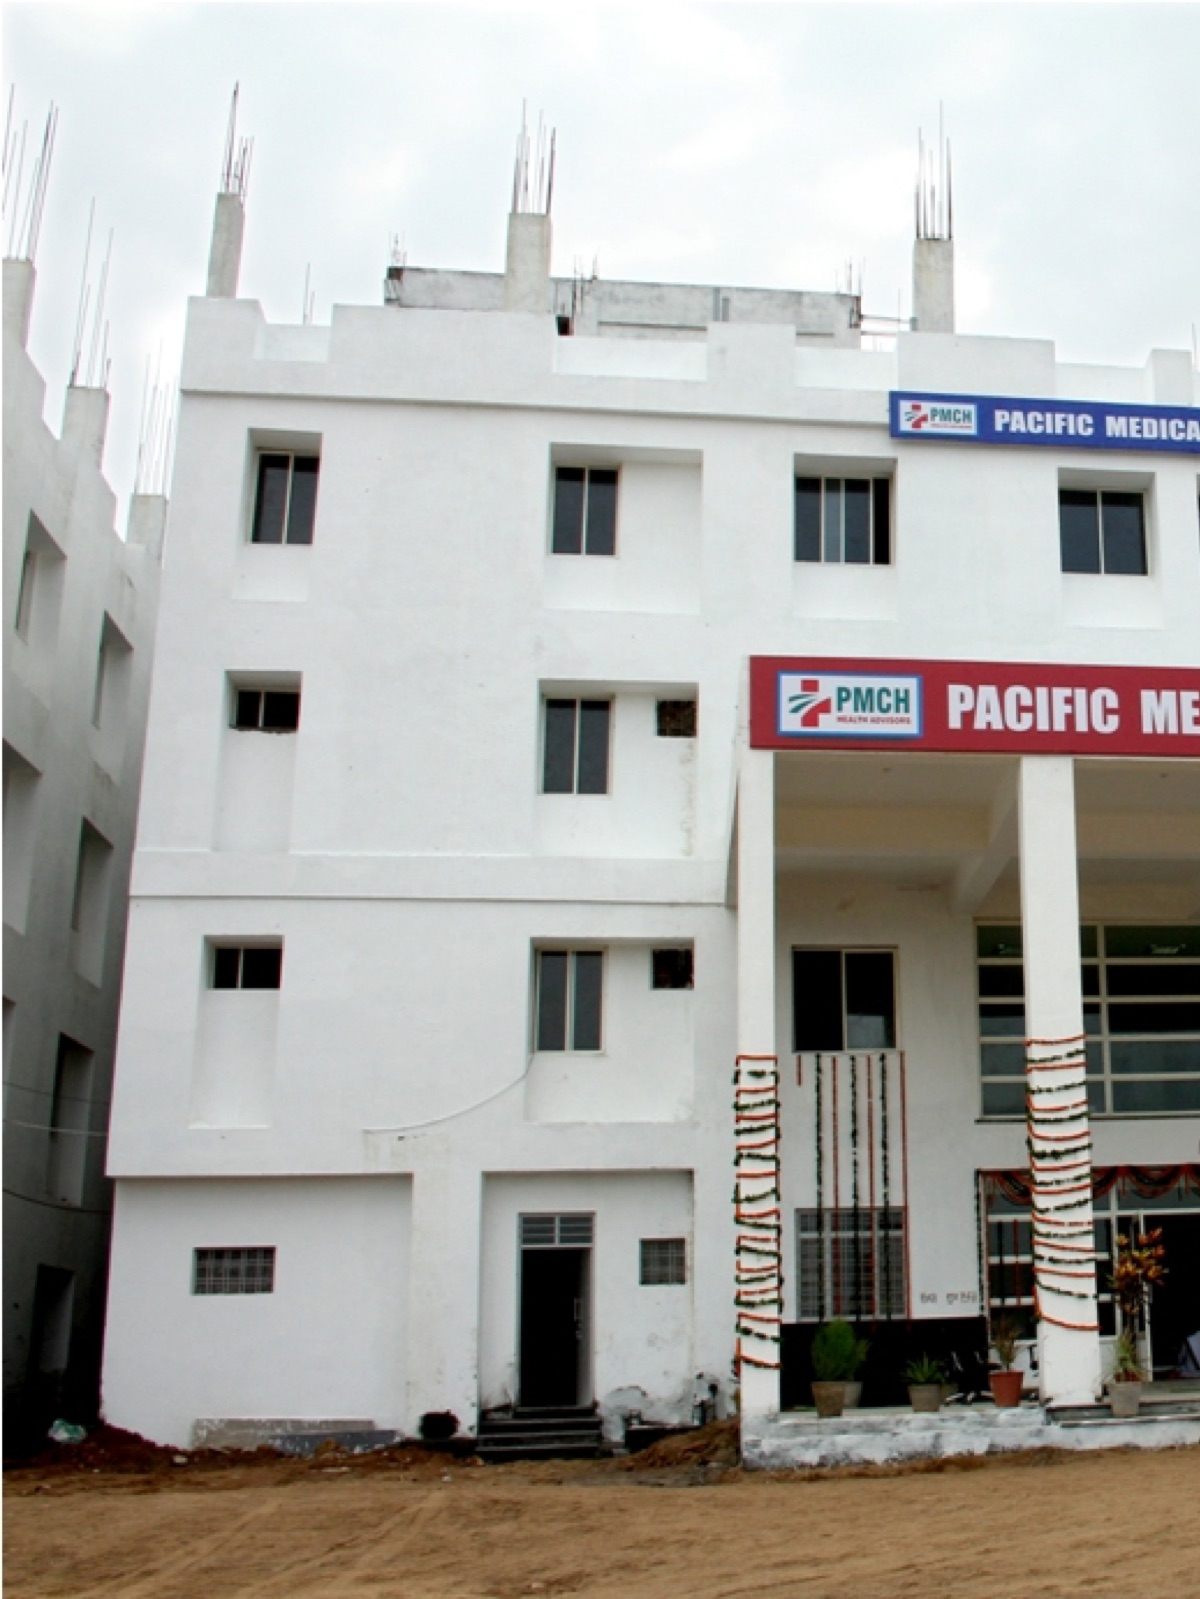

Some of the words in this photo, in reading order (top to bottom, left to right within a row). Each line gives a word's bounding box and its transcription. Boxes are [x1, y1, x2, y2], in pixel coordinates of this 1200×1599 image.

[930, 407, 972, 423] PMCH
[994, 408, 1094, 437] PACIFIC
[837, 686, 910, 713] PMCH
[948, 684, 1119, 734] PACIFIC
[836, 715, 869, 724] HEALTH
